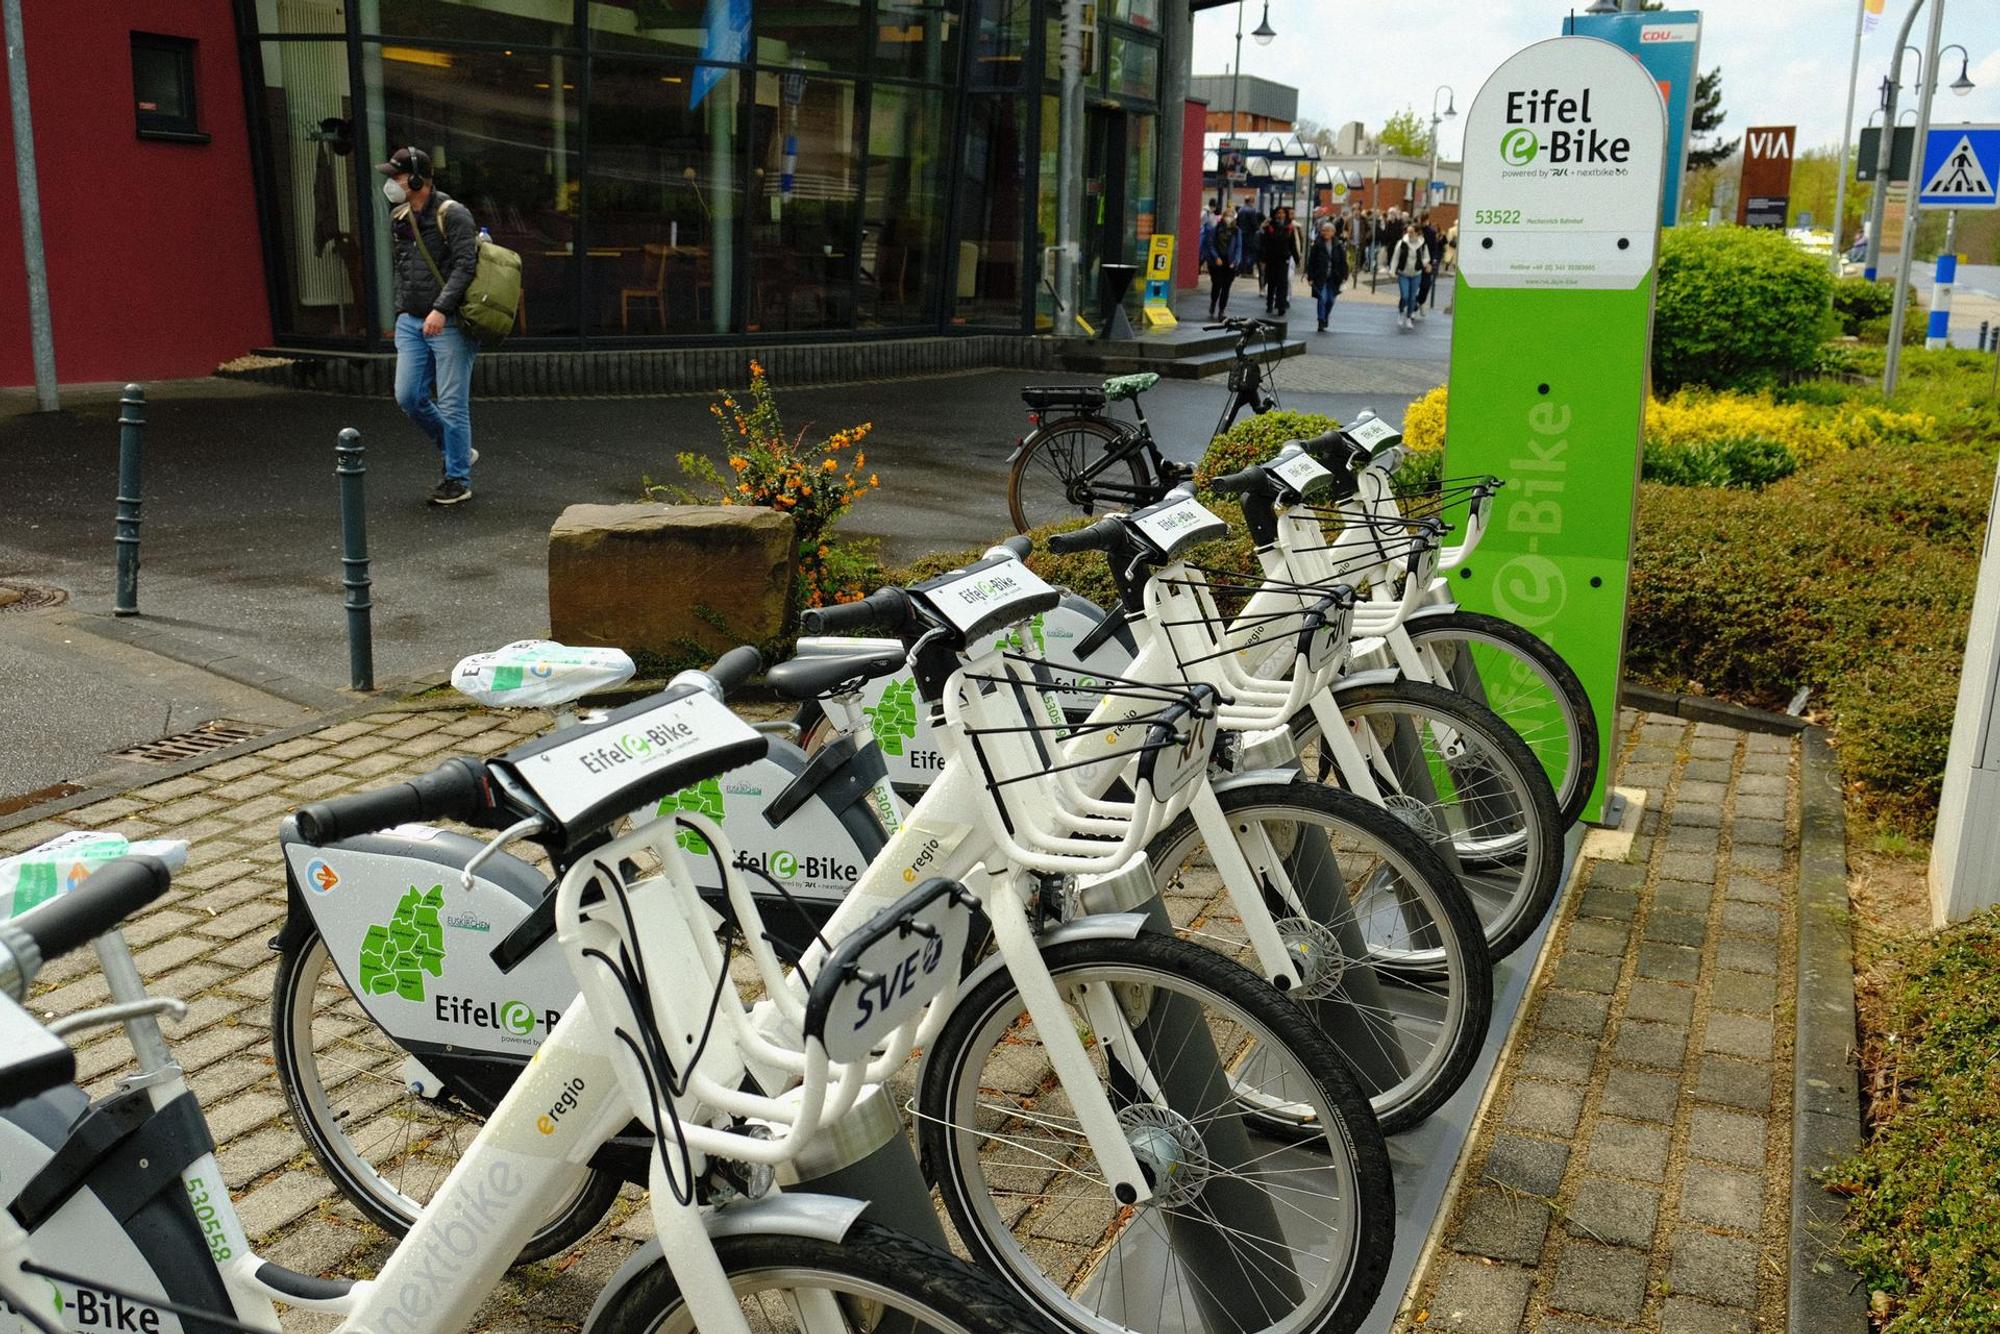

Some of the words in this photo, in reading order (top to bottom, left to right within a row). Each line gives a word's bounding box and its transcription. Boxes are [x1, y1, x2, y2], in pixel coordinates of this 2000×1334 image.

[1643, 31, 1671, 41] CDU
[1506, 88, 1592, 124] Eifel
[1500, 128, 1631, 167] e-Bike
[1749, 132, 1790, 159] VIA
[1502, 168, 1538, 179] powered
[1539, 168, 1549, 179] by
[1577, 168, 1614, 177] nextbike
[1475, 210, 1521, 225] 53522
[1492, 401, 1573, 627] e-Bike
[958, 585, 988, 604] Eifel
[1043, 695, 1067, 739] 53059
[579, 742, 633, 774] Eifel
[620, 722, 694, 757] e-Bike
[910, 750, 946, 770] Eife
[733, 850, 769, 875] fel
[769, 850, 858, 881] e-Bike
[447, 915, 490, 931] EUSKIRCHEN
[853, 948, 920, 1031] SVE
[435, 994, 500, 1030] Eifel
[501, 1035, 532, 1046] powered
[186, 1178, 232, 1262] 530558
[377, 1160, 524, 1334] nextbike
[54, 1284, 160, 1334] -Bike
